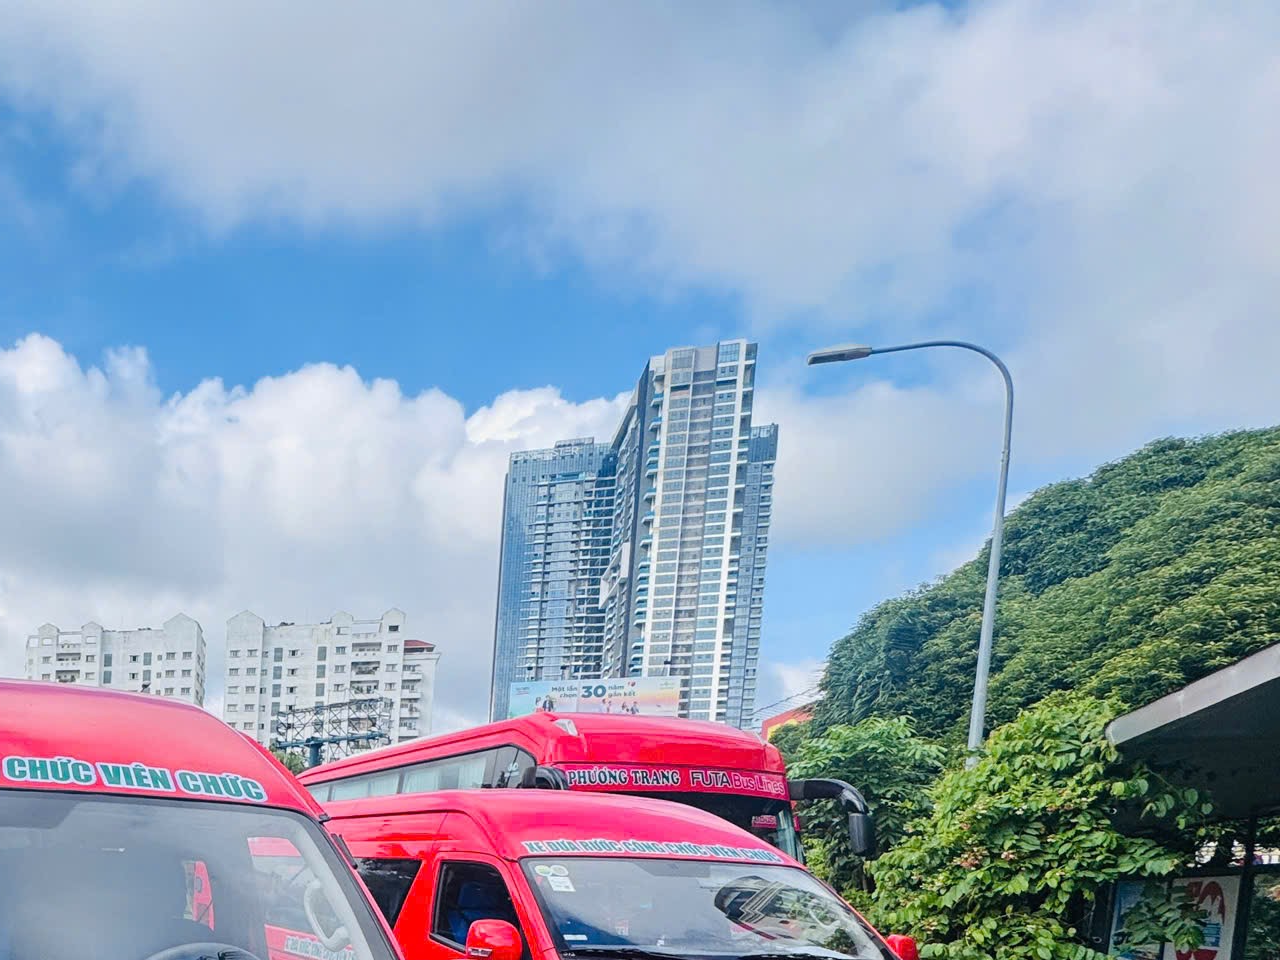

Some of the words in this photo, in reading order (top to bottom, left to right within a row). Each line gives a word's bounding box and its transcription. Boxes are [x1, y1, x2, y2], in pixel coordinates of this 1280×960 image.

[581, 684, 607, 698] 30
[5, 757, 94, 784] CHỨC
[99, 763, 172, 790] VIÊN
[178, 773, 265, 801] CHỨC
[568, 767, 628, 785] PHƯƠNG
[632, 769, 680, 786] TRANG
[691, 771, 732, 787] FUTA
[732, 772, 755, 790] Bus
[755, 775, 785, 794] Lines
[523, 840, 546, 853] XE
[623, 839, 666, 854] CÔNG
